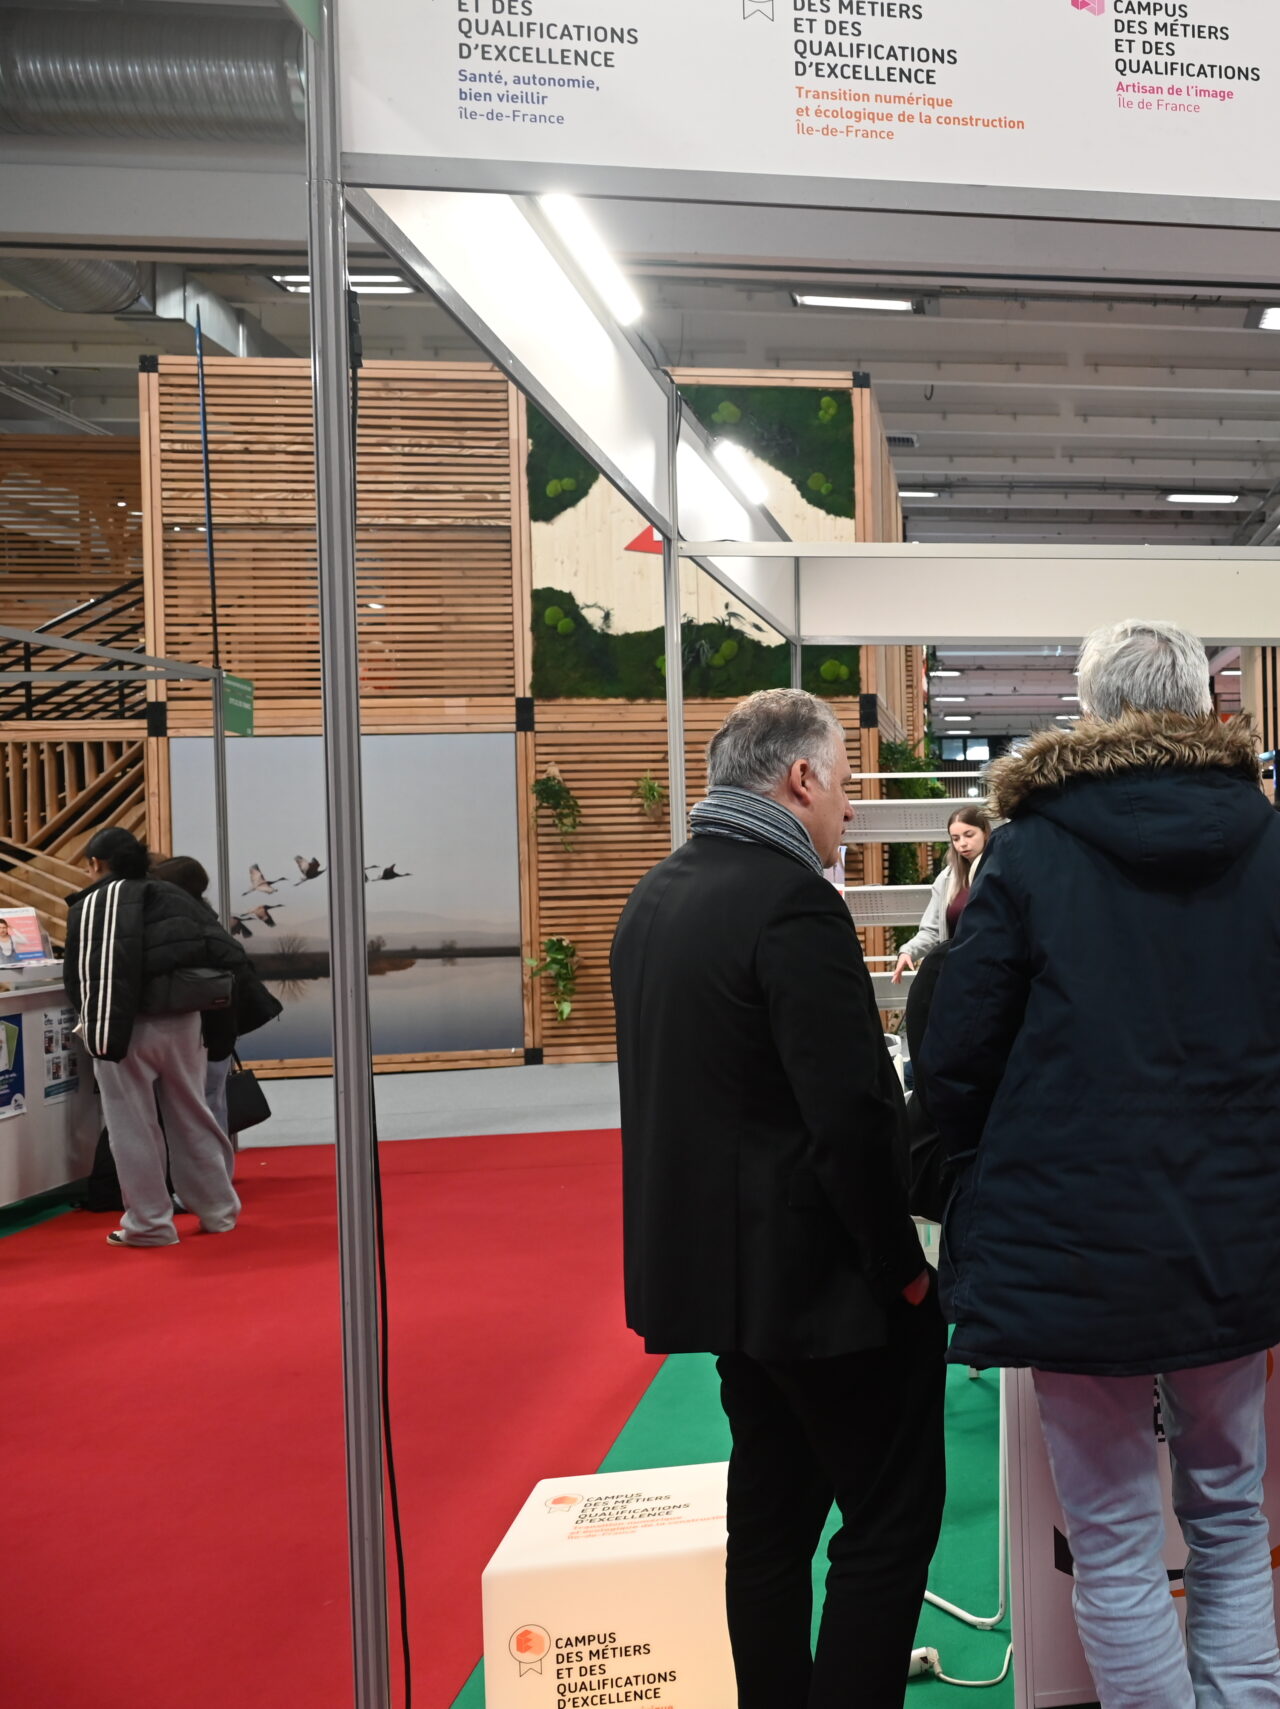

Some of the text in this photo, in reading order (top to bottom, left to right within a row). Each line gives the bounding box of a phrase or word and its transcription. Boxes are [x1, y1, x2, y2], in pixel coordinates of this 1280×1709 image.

[492, 0, 532, 16] DES
[794, 0, 830, 13] DES
[1114, 0, 1187, 18] CAMPUS
[458, 18, 638, 44] QUALIFICATIONS
[794, 18, 861, 36] ET DES
[1115, 19, 1229, 40] DES MÉTIERS
[459, 43, 615, 68] D'EXCELLENCE
[794, 39, 957, 64] QUALIFICATIONS
[1115, 39, 1175, 56] ET DES
[795, 61, 936, 84] D'EXCELLENCE
[1115, 58, 1260, 81] QUALIFICATIONS
[458, 69, 599, 91] Santé, autonomie,
[459, 88, 548, 105] bien vieillir
[795, 86, 953, 109] Transition numérique
[1116, 82, 1234, 101] Artisan de l'image
[1118, 94, 1200, 112] Île de France
[458, 106, 564, 124] île-de-France
[796, 105, 1024, 129] et écologique de la construction
[796, 119, 894, 140] Île-de-France
[586, 1492, 642, 1502] CAMPUS
[578, 1503, 690, 1519] QUALIFICATIONS
[555, 1632, 617, 1649] CAMPUS
[556, 1643, 651, 1664] DES MÉTIERS
[556, 1664, 606, 1679] ET DES
[557, 1671, 677, 1697] QUALIFICATIONS
[557, 1687, 661, 1709] D'EXCELLENCE
